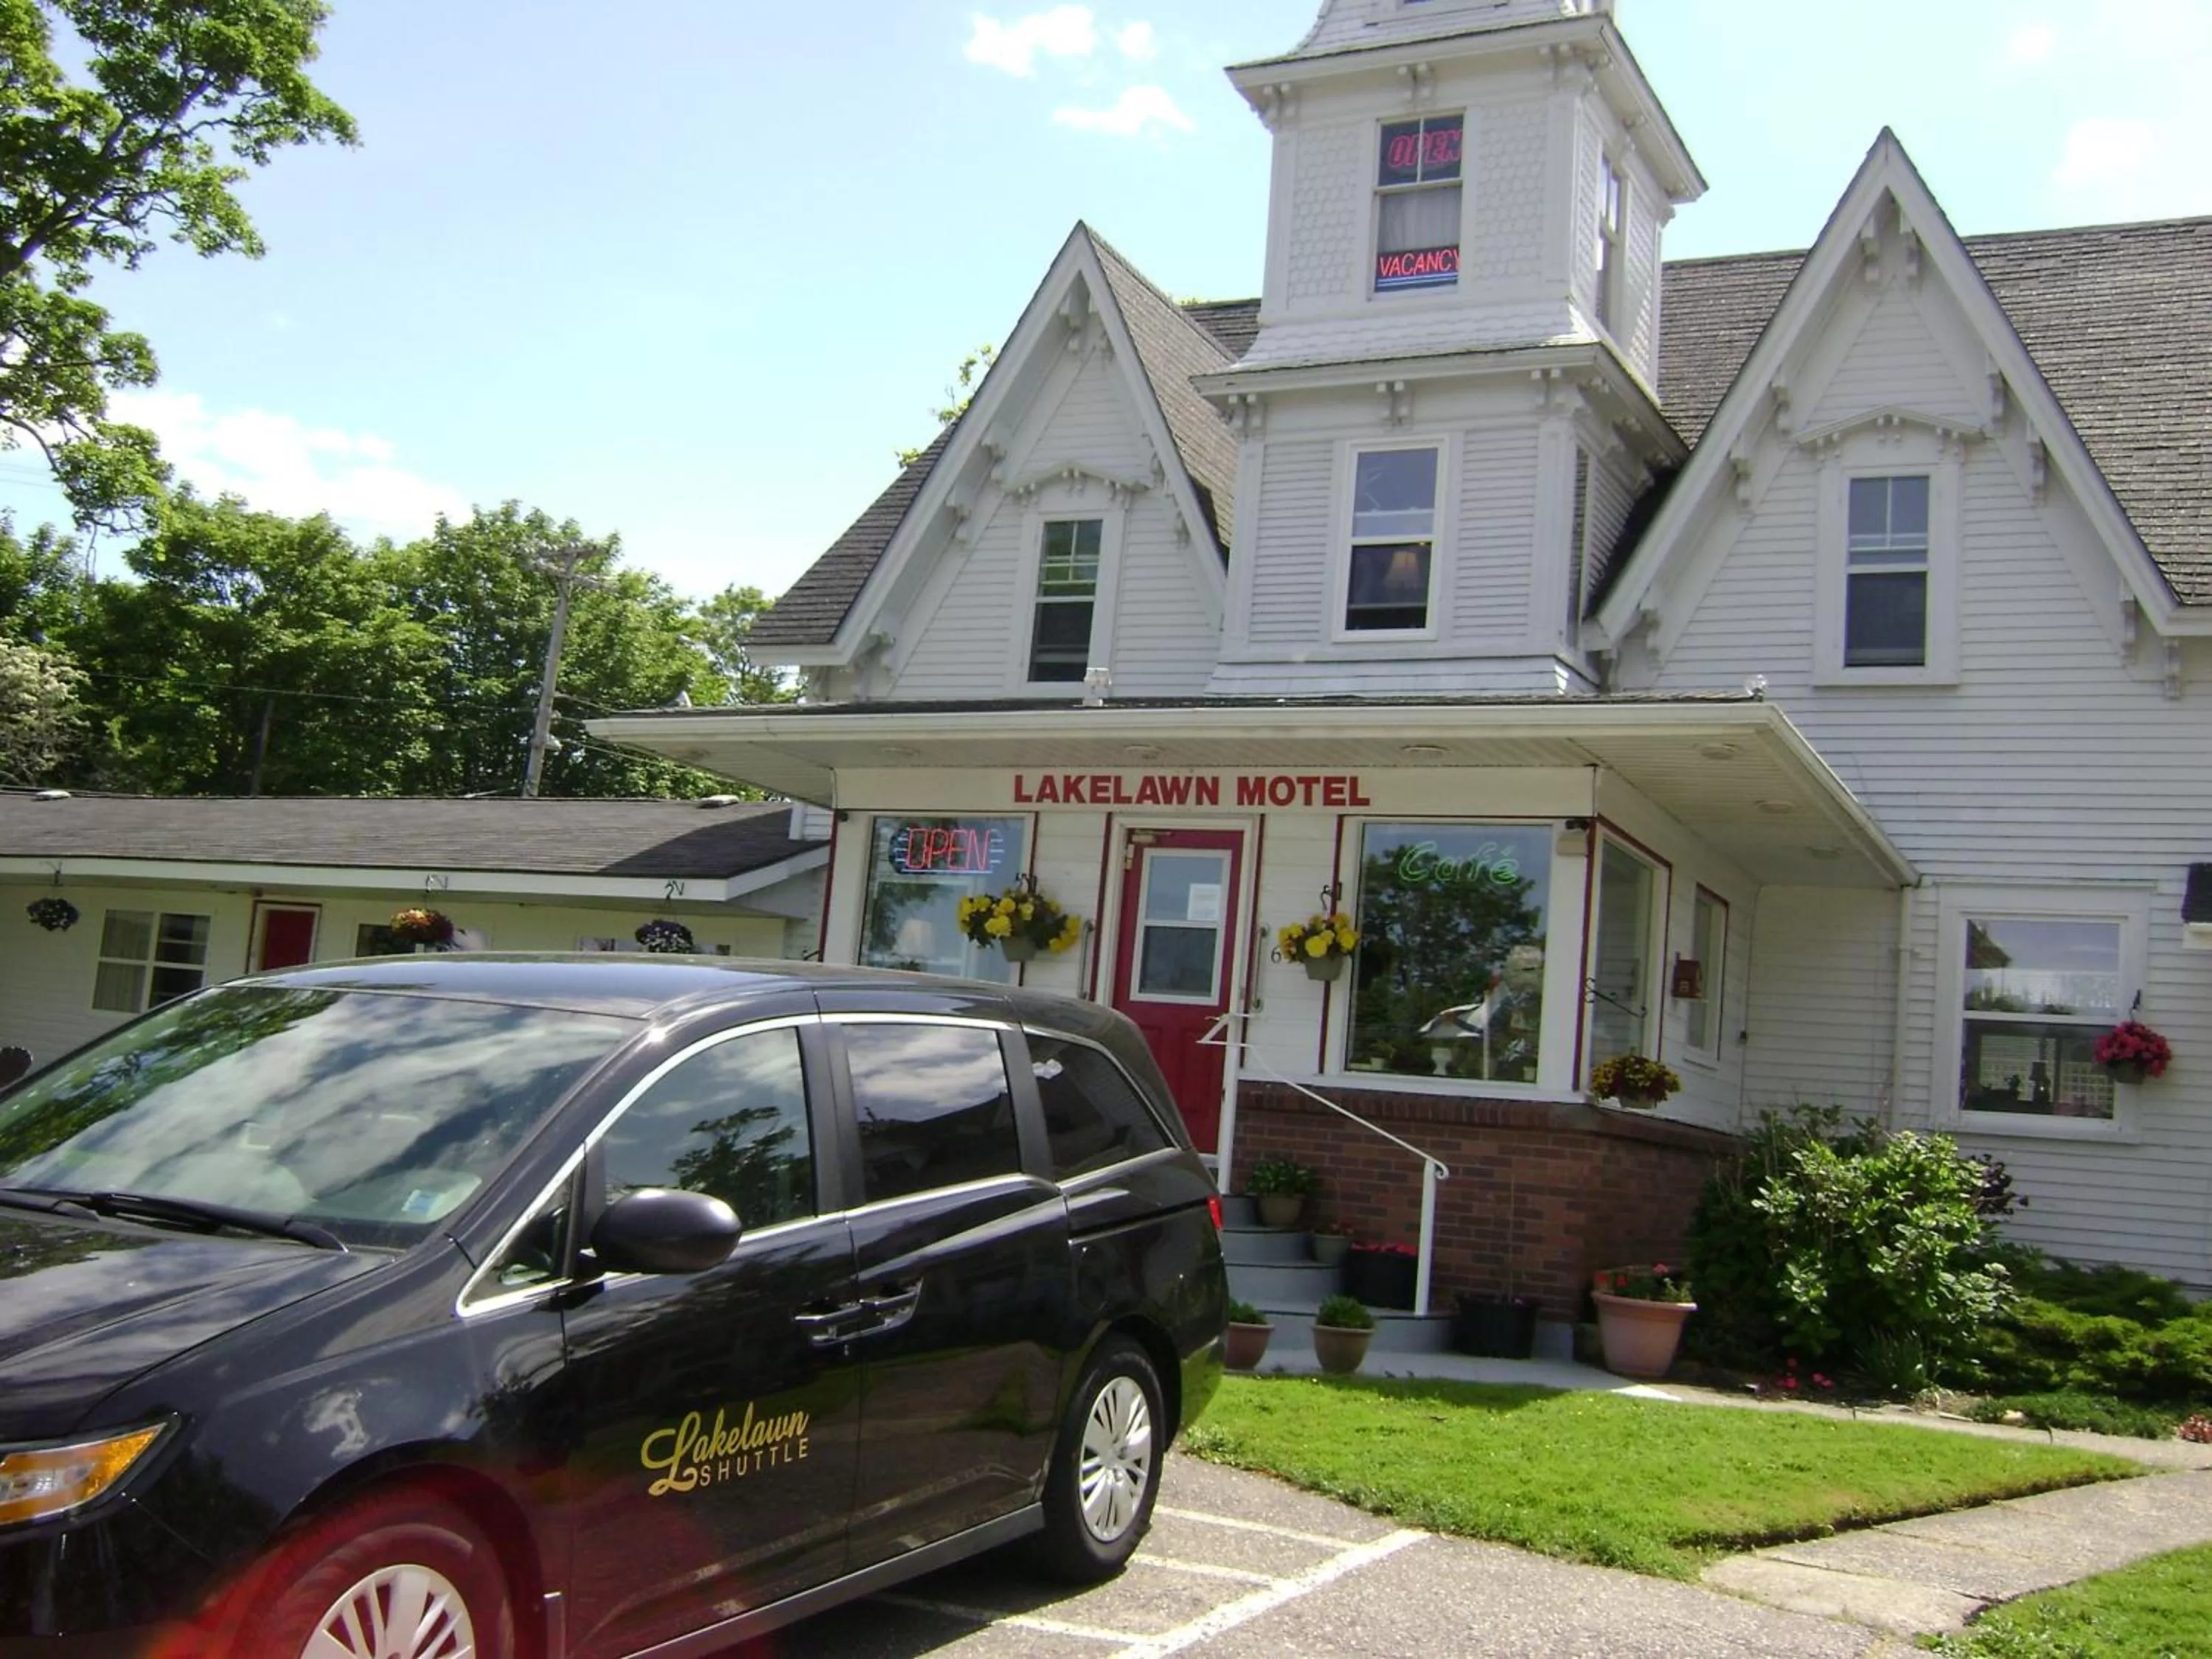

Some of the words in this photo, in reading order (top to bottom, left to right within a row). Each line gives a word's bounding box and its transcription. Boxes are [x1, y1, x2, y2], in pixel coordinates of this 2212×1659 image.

[1014, 774, 1220, 805] LAKELAWN
[1237, 776, 1371, 806] MOTEL
[905, 828, 992, 871] OPEN
[641, 1402, 810, 1496] Lakelawn
[700, 1438, 809, 1487] SHUTTLE
